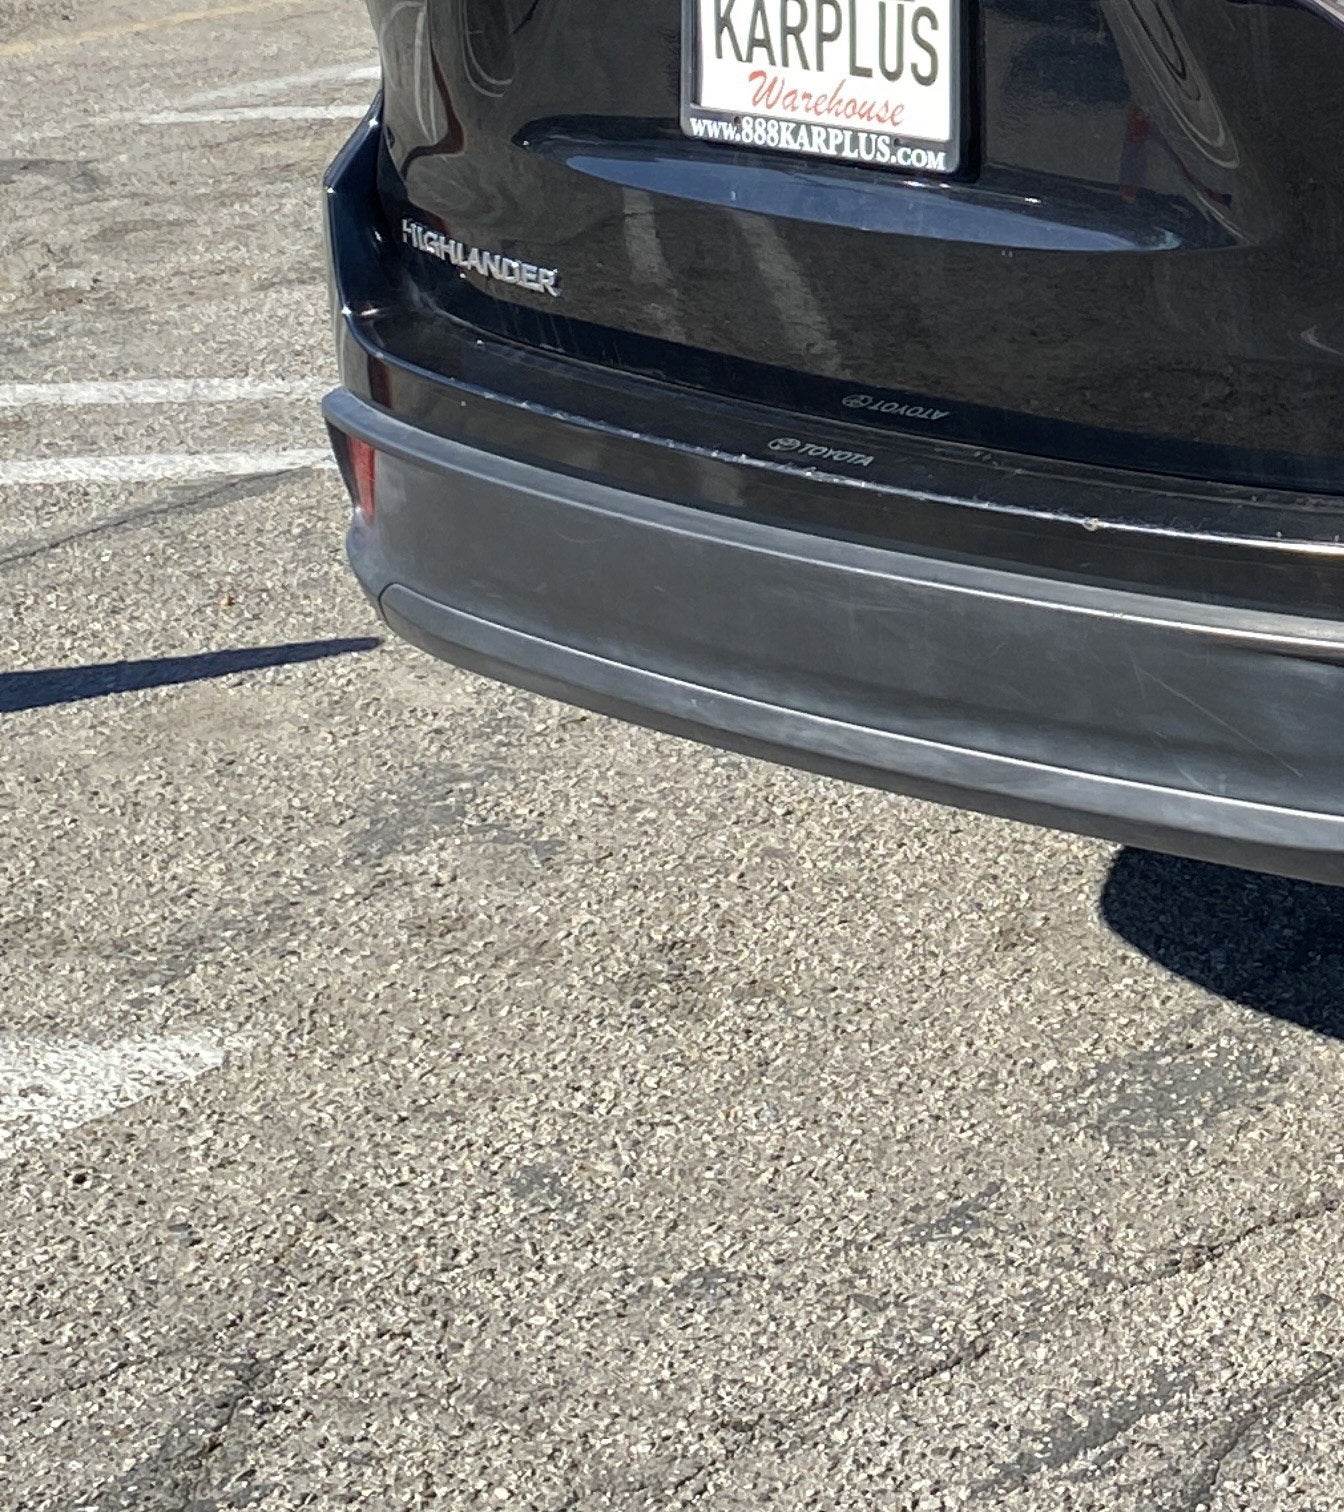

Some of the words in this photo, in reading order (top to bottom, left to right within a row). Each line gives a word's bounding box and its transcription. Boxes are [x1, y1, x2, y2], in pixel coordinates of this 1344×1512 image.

[748, 70, 905, 127] Warehouse
[402, 218, 561, 298] HIGHLANDER
[798, 443, 874, 467] TOYOTA
